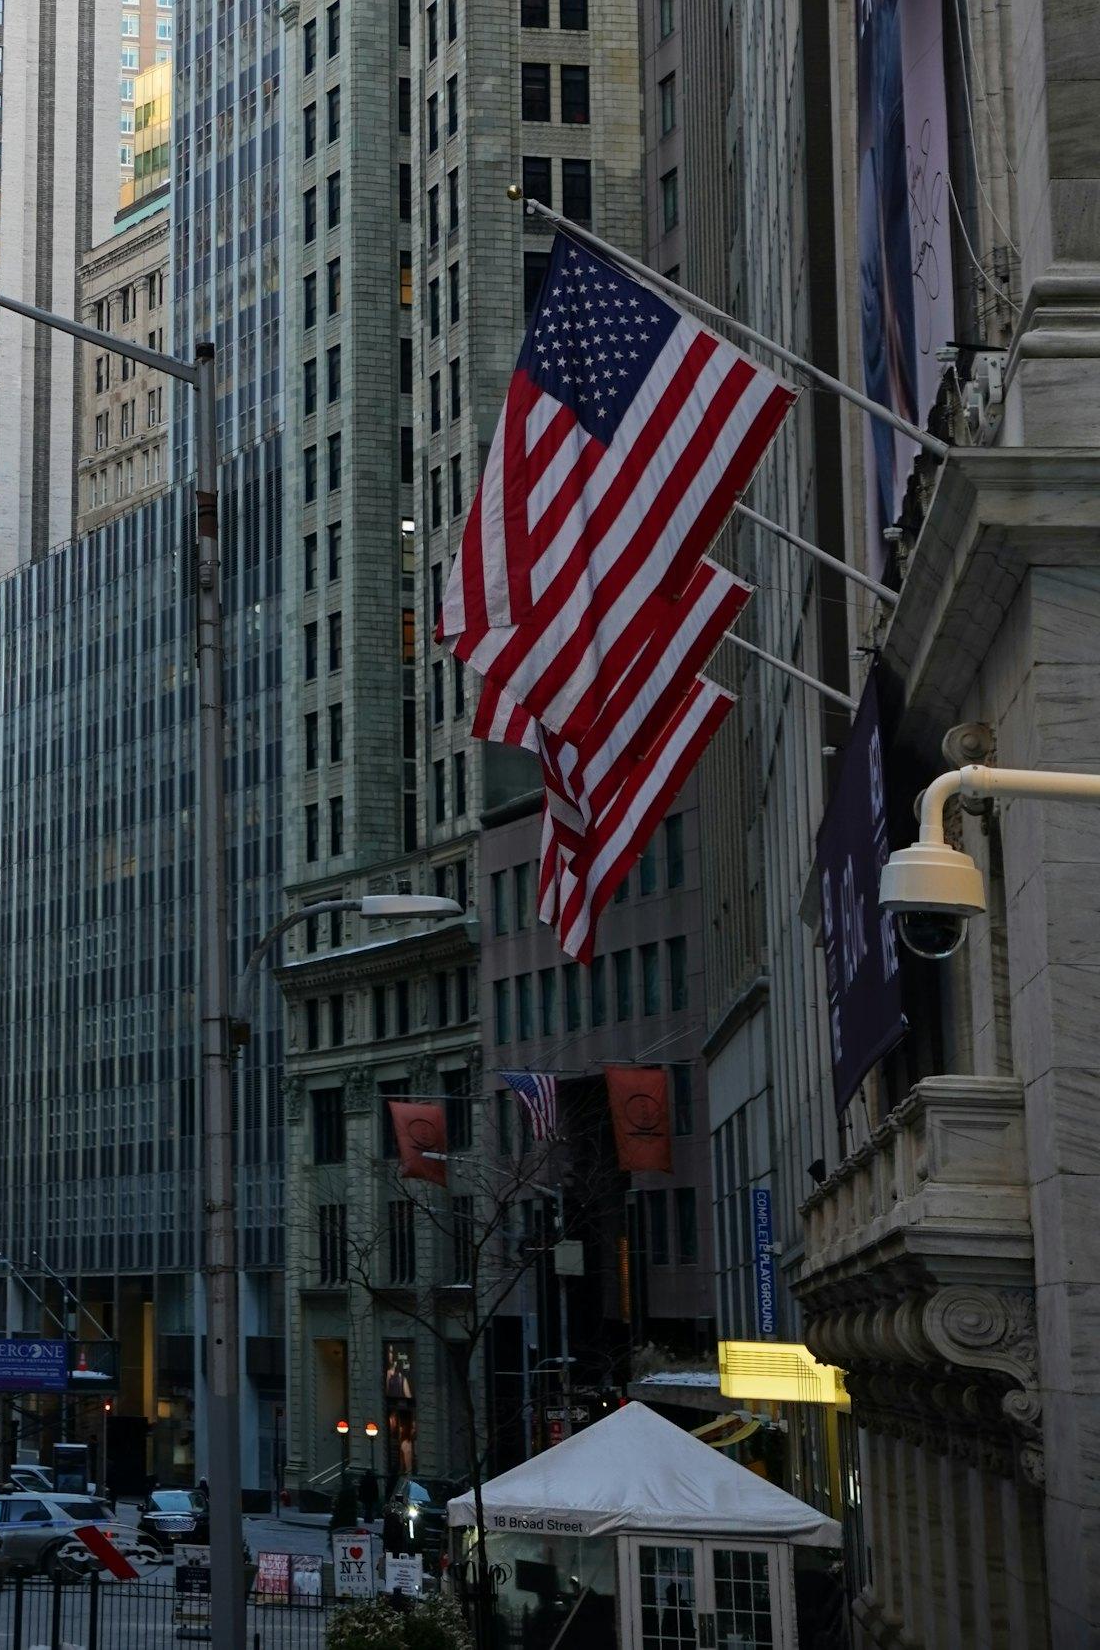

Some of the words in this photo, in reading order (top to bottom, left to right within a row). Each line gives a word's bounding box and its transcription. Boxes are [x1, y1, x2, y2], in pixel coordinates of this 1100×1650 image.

[759, 1253, 773, 1333] PLAYGROUND
[493, 1516, 506, 1528] 18
[509, 1517, 544, 1530] Broad
[546, 1520, 585, 1533] Street
[342, 1546, 349, 1560] I
[340, 1561, 367, 1574] NY
[340, 1574, 368, 1583] GIFTS
